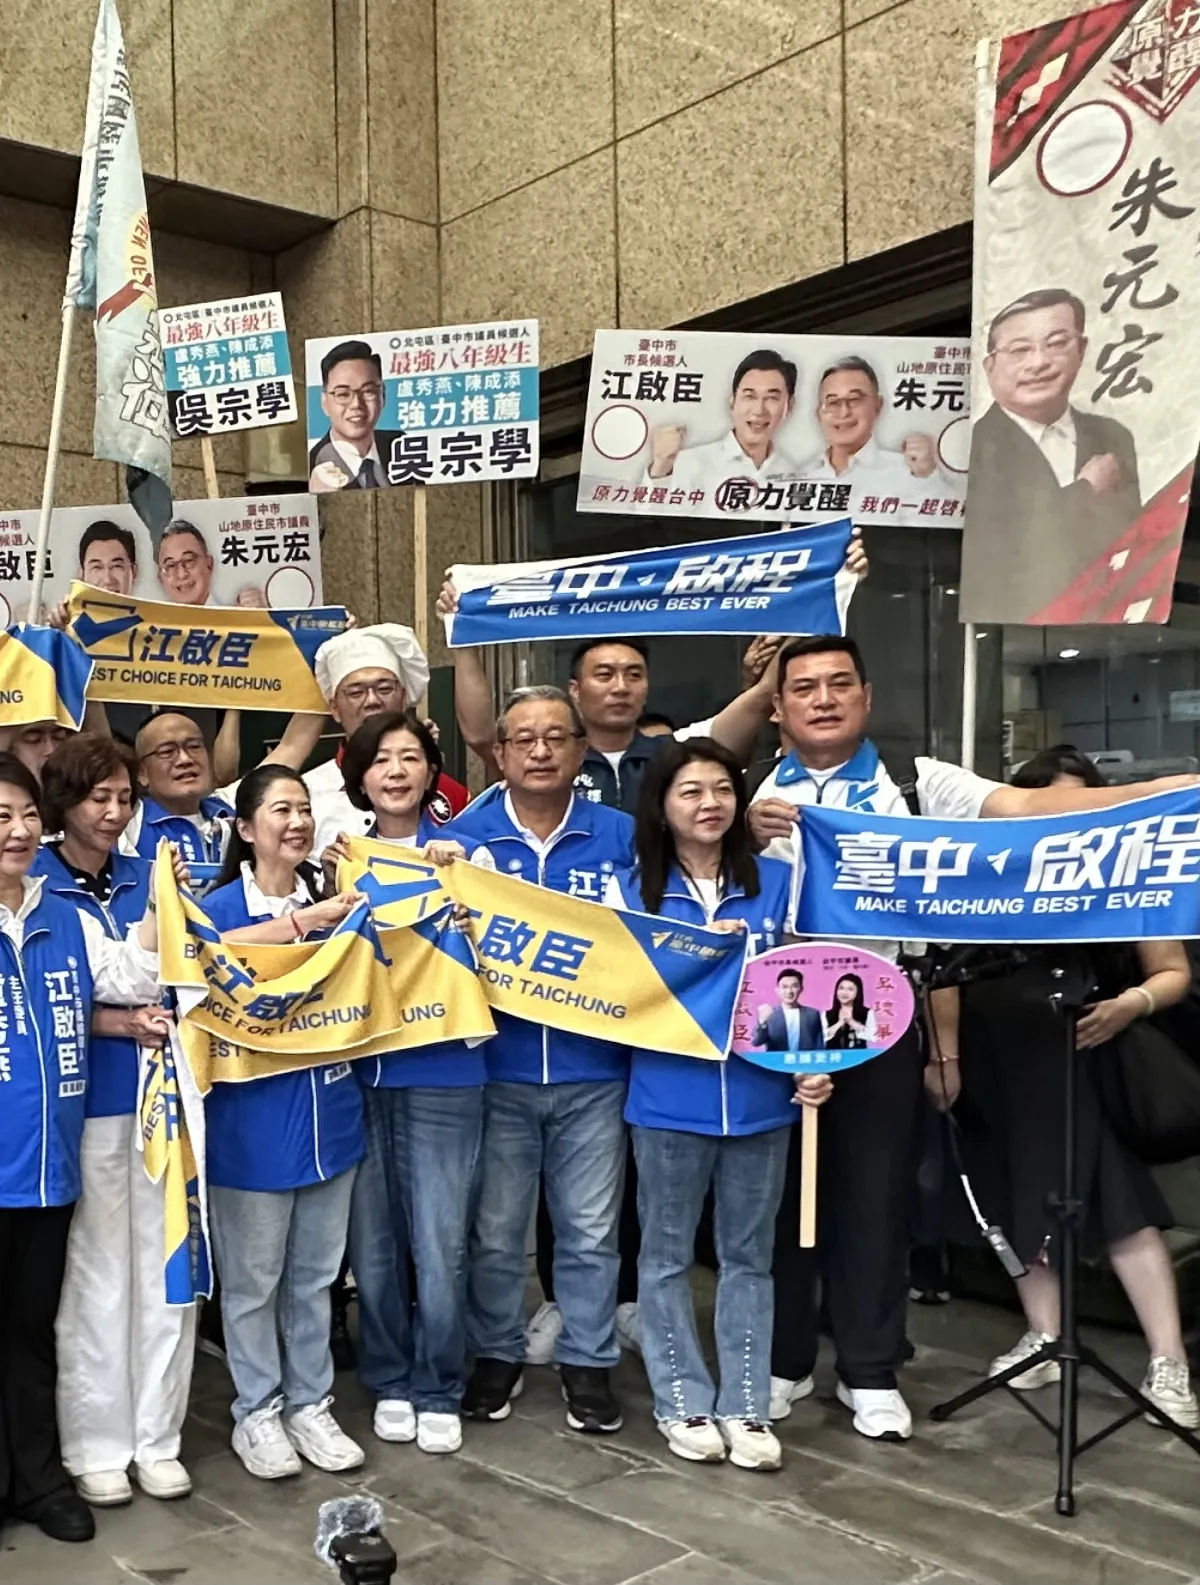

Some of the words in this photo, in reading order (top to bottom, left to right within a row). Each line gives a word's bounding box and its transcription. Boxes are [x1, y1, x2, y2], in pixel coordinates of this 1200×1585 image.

[1091, 156, 1196, 403] 朱元宏
[166, 310, 279, 345] 最強八年級生
[403, 336, 435, 348] 北屯區
[389, 341, 532, 375] 最強八年級生
[623, 354, 688, 368] 市長候選人
[638, 338, 677, 352] 臺中市
[177, 352, 277, 389] 強力推薦
[397, 371, 522, 398] 盧秀燕、陳成添
[601, 370, 704, 403] 江啟臣
[178, 381, 290, 432] 吳宗學
[397, 392, 522, 430] 強力推薦
[893, 378, 970, 412] 朱元
[391, 427, 532, 482] 吳宗學
[246, 502, 281, 516] 臺中市
[592, 484, 705, 506] 原力覺醒台中
[722, 477, 853, 512] 原力覺醒
[221, 532, 311, 567] 朱元宏
[508, 604, 560, 619] MAKE
[568, 598, 660, 615] TAICHUNG
[665, 596, 714, 611] BEST
[720, 595, 770, 611] EVER
[140, 625, 259, 669] 江啟臣
[121, 669, 176, 685] CHOICE
[180, 672, 208, 687] FOR
[212, 674, 282, 691] TAICHUNG
[832, 831, 978, 895] 臺中
[855, 896, 907, 913] MAKE
[916, 898, 1025, 916] TAICHUNG
[1032, 894, 1098, 914] BEST
[1106, 889, 1173, 910] EVER
[468, 907, 595, 982] 啟臣
[520, 978, 628, 1019] TAICHUNG
[44, 971, 79, 1076] 江啟臣
[235, 1017, 275, 1037] FOR
